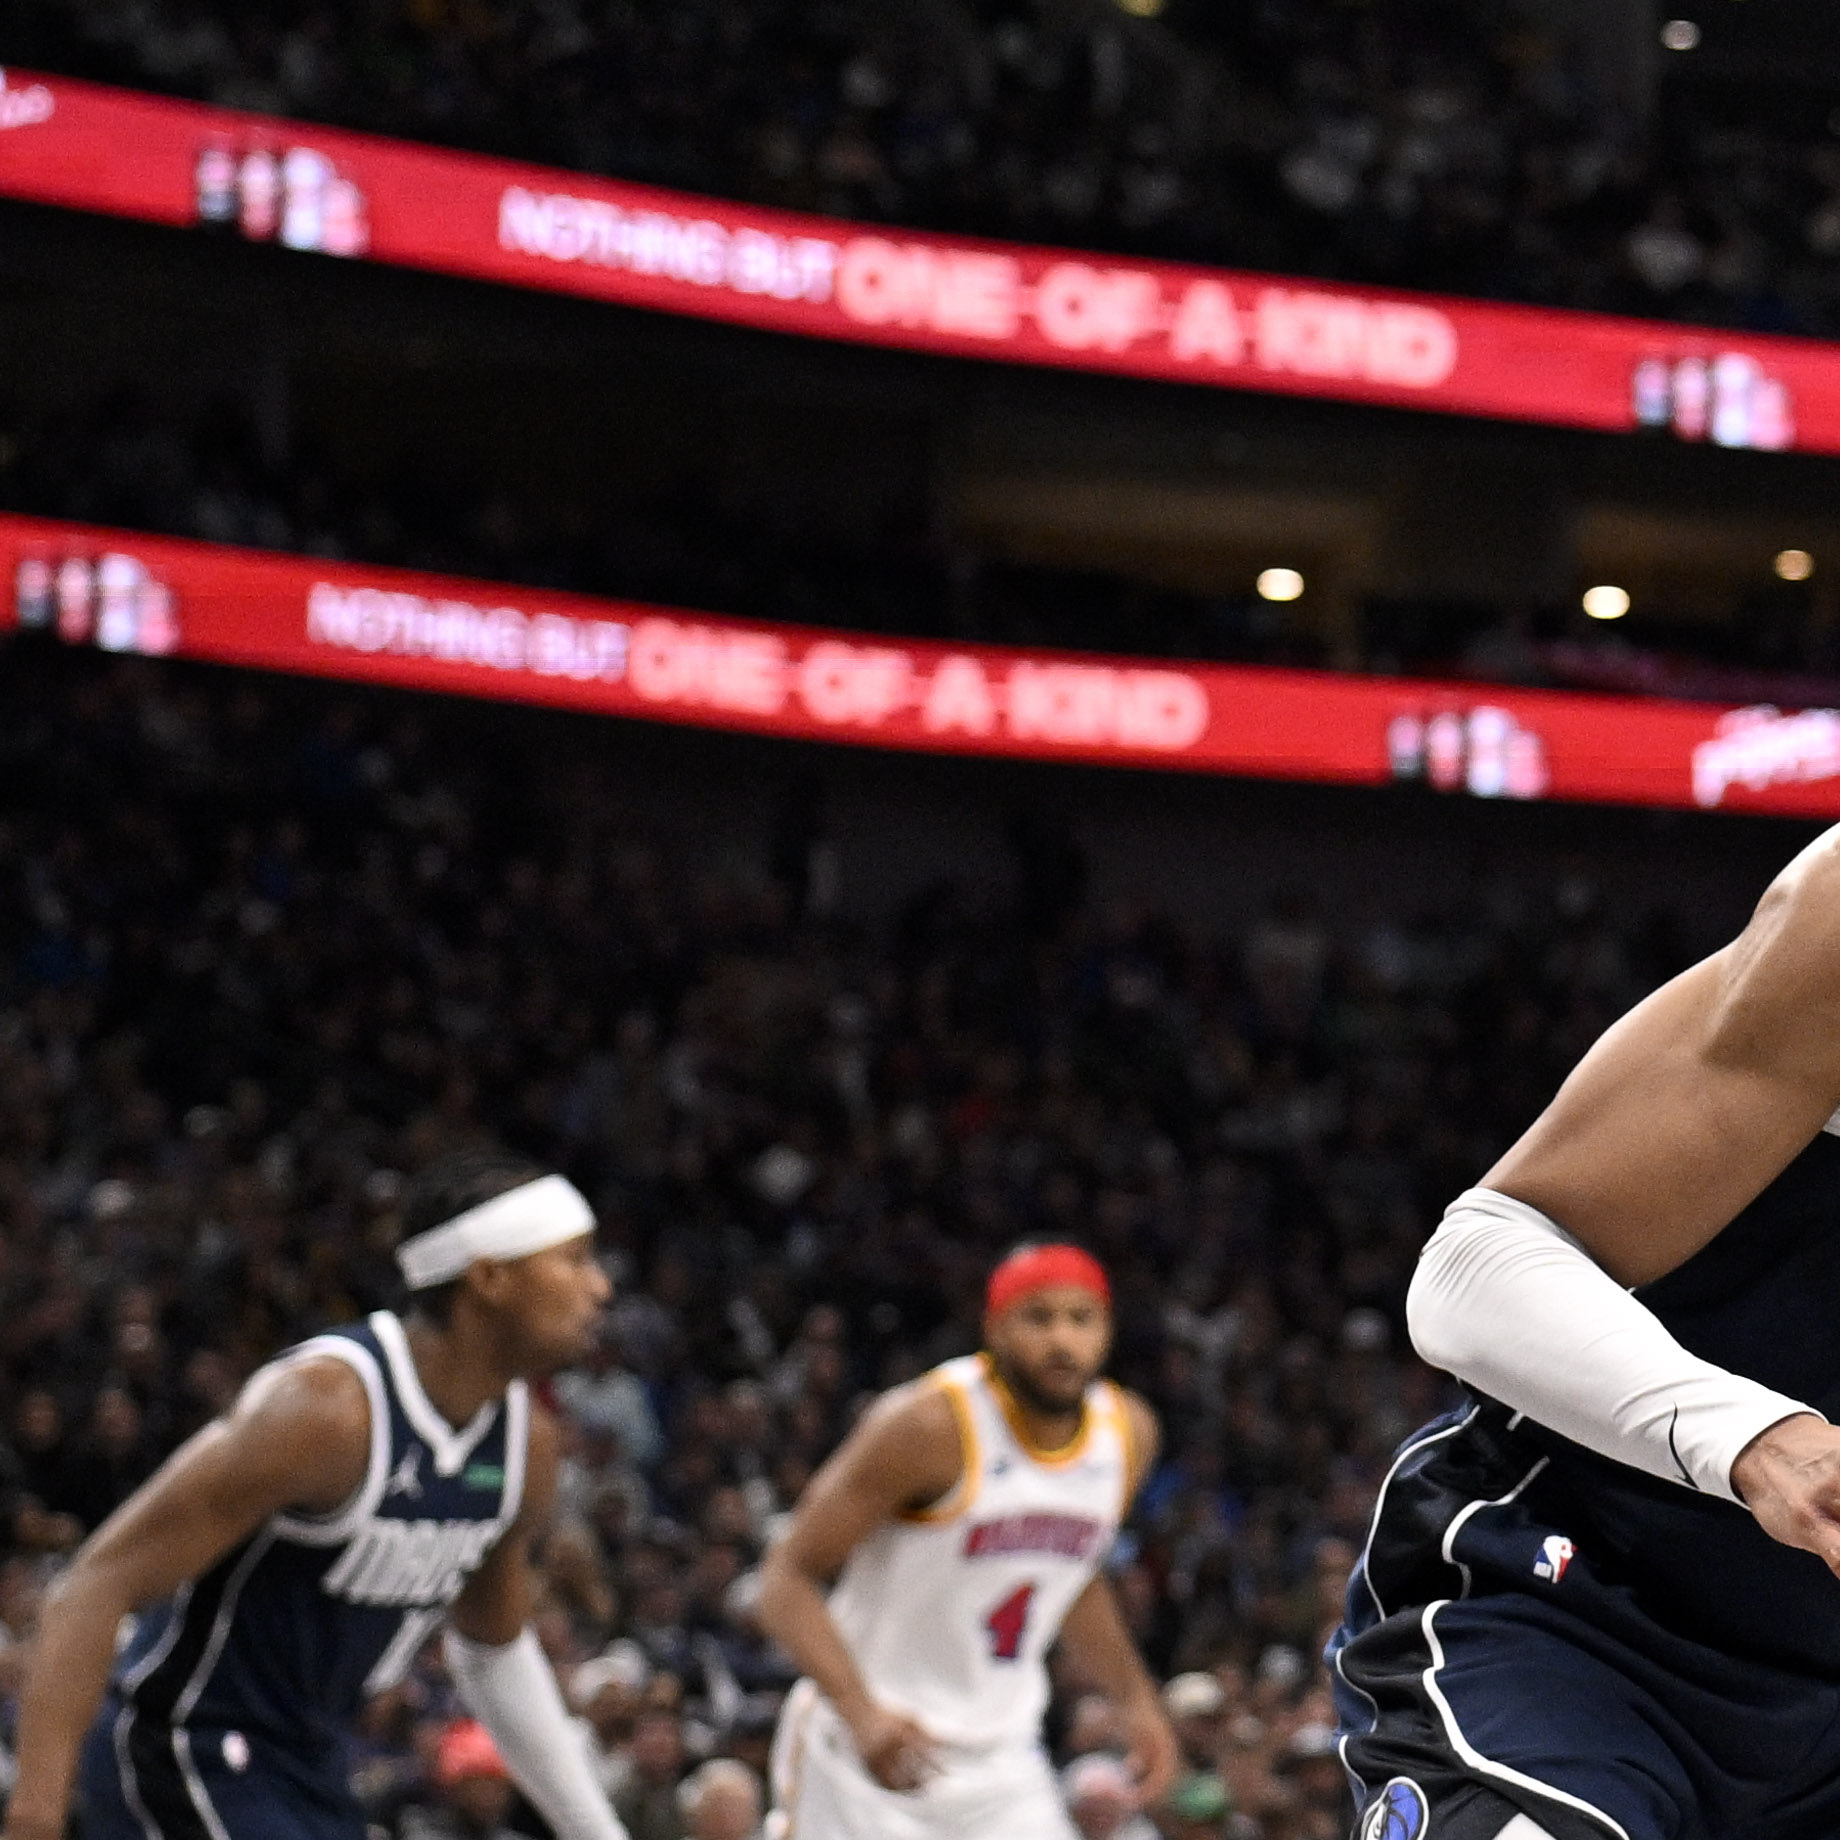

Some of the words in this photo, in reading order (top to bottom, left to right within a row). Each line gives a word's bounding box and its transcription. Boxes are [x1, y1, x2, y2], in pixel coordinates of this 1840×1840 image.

[499, 186, 728, 286] NOTHING
[728, 227, 835, 303] BUT
[984, 1582, 1034, 1664] 4
